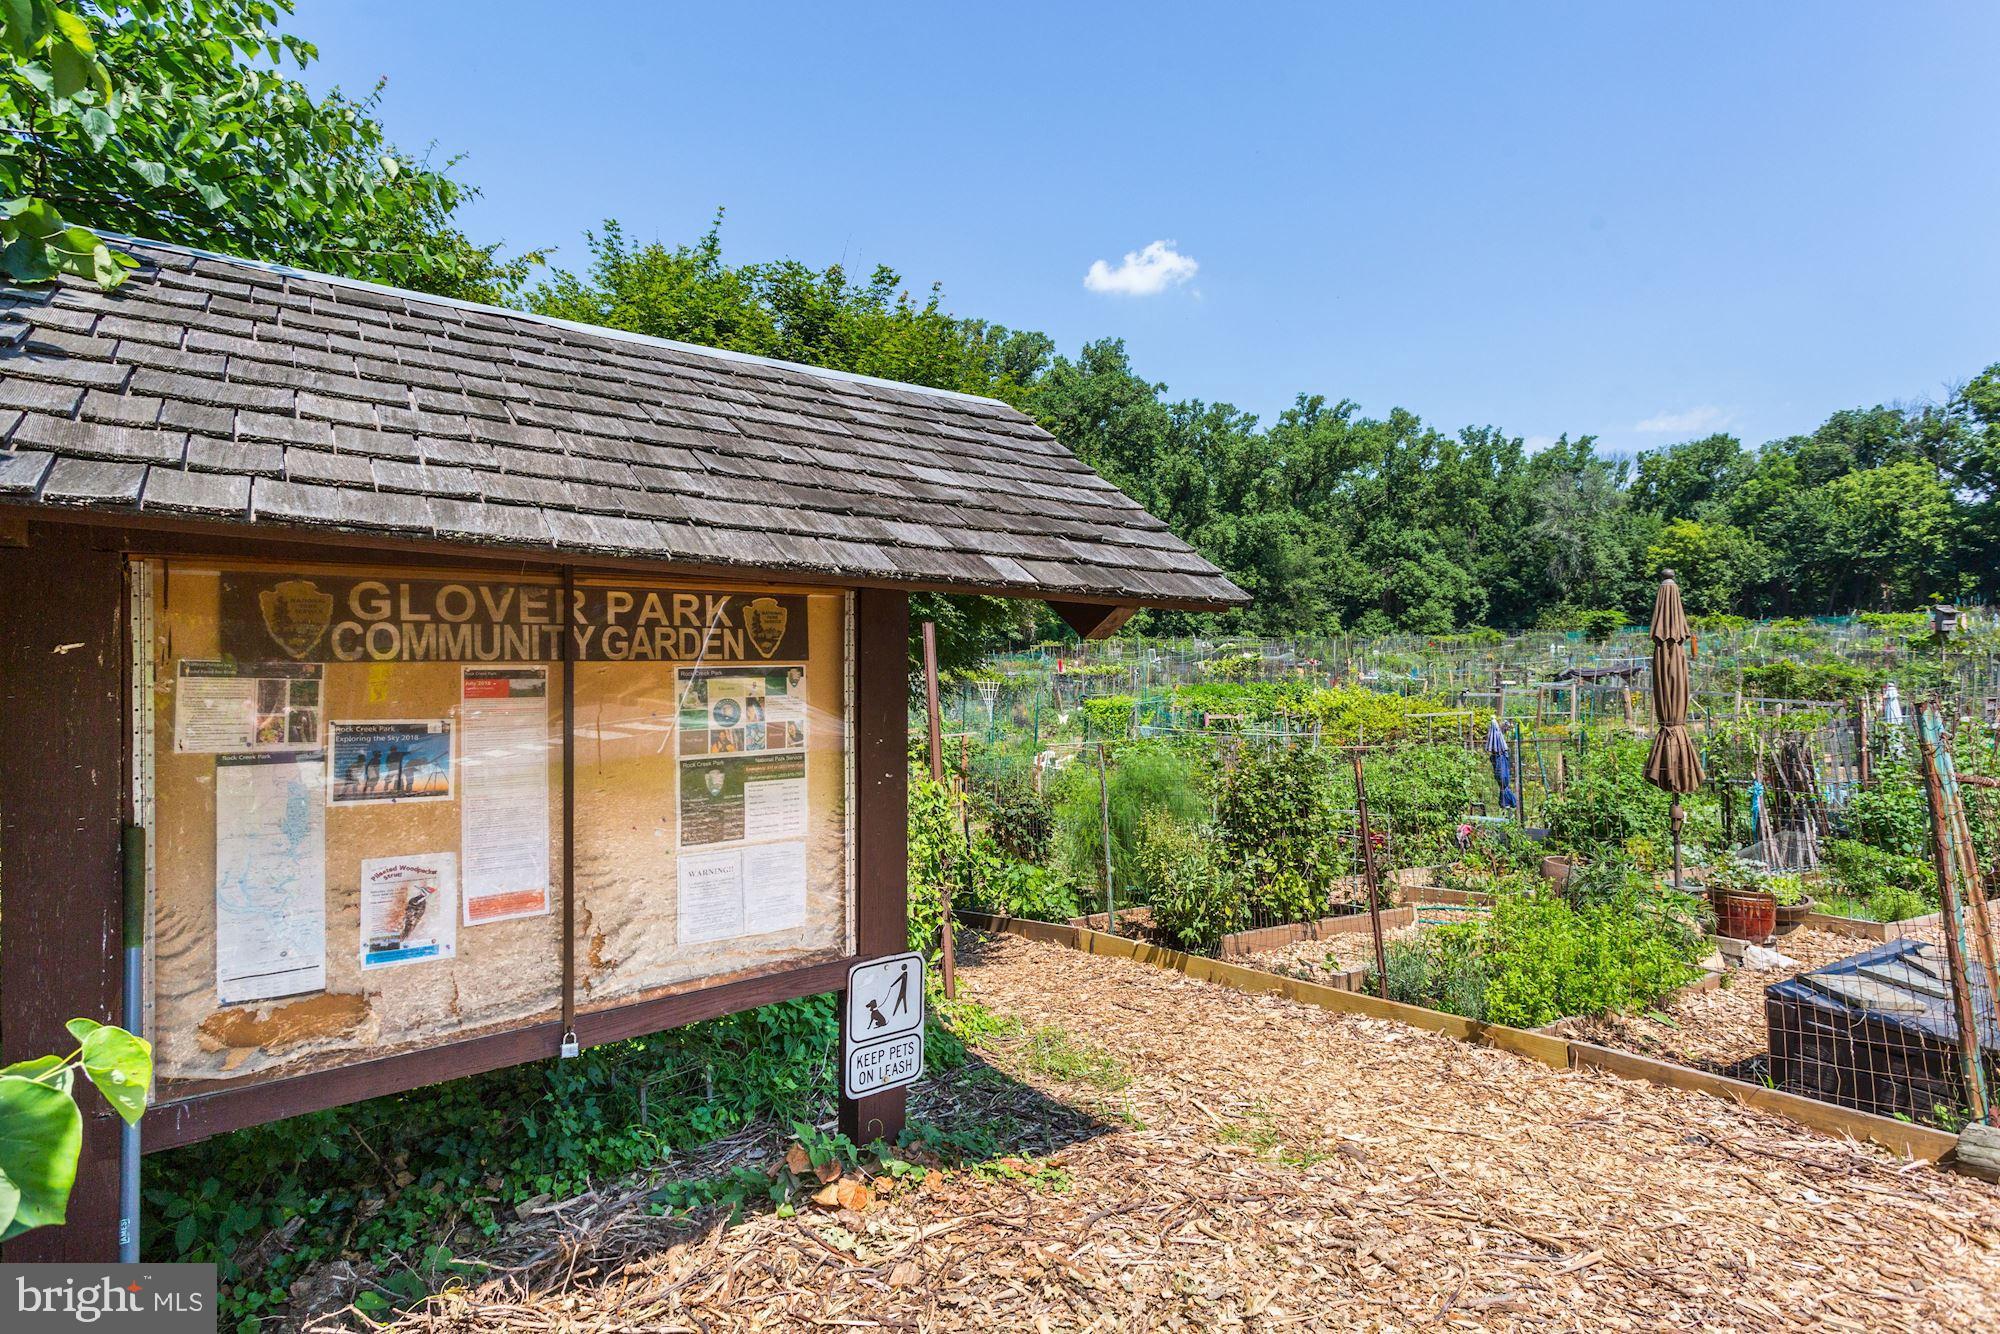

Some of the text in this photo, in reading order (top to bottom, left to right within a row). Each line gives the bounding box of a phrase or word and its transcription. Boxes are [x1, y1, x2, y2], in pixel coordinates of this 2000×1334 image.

[348, 581, 733, 627] GLOVER PARK
[331, 621, 744, 661] COMMUNITY GARDEN
[335, 736, 372, 744] Exploring
[387, 734, 399, 742] Sky
[688, 865, 734, 878] WARNING!!
[857, 1041, 914, 1070] KEEP PETS
[859, 1058, 912, 1086] ON LEASH
